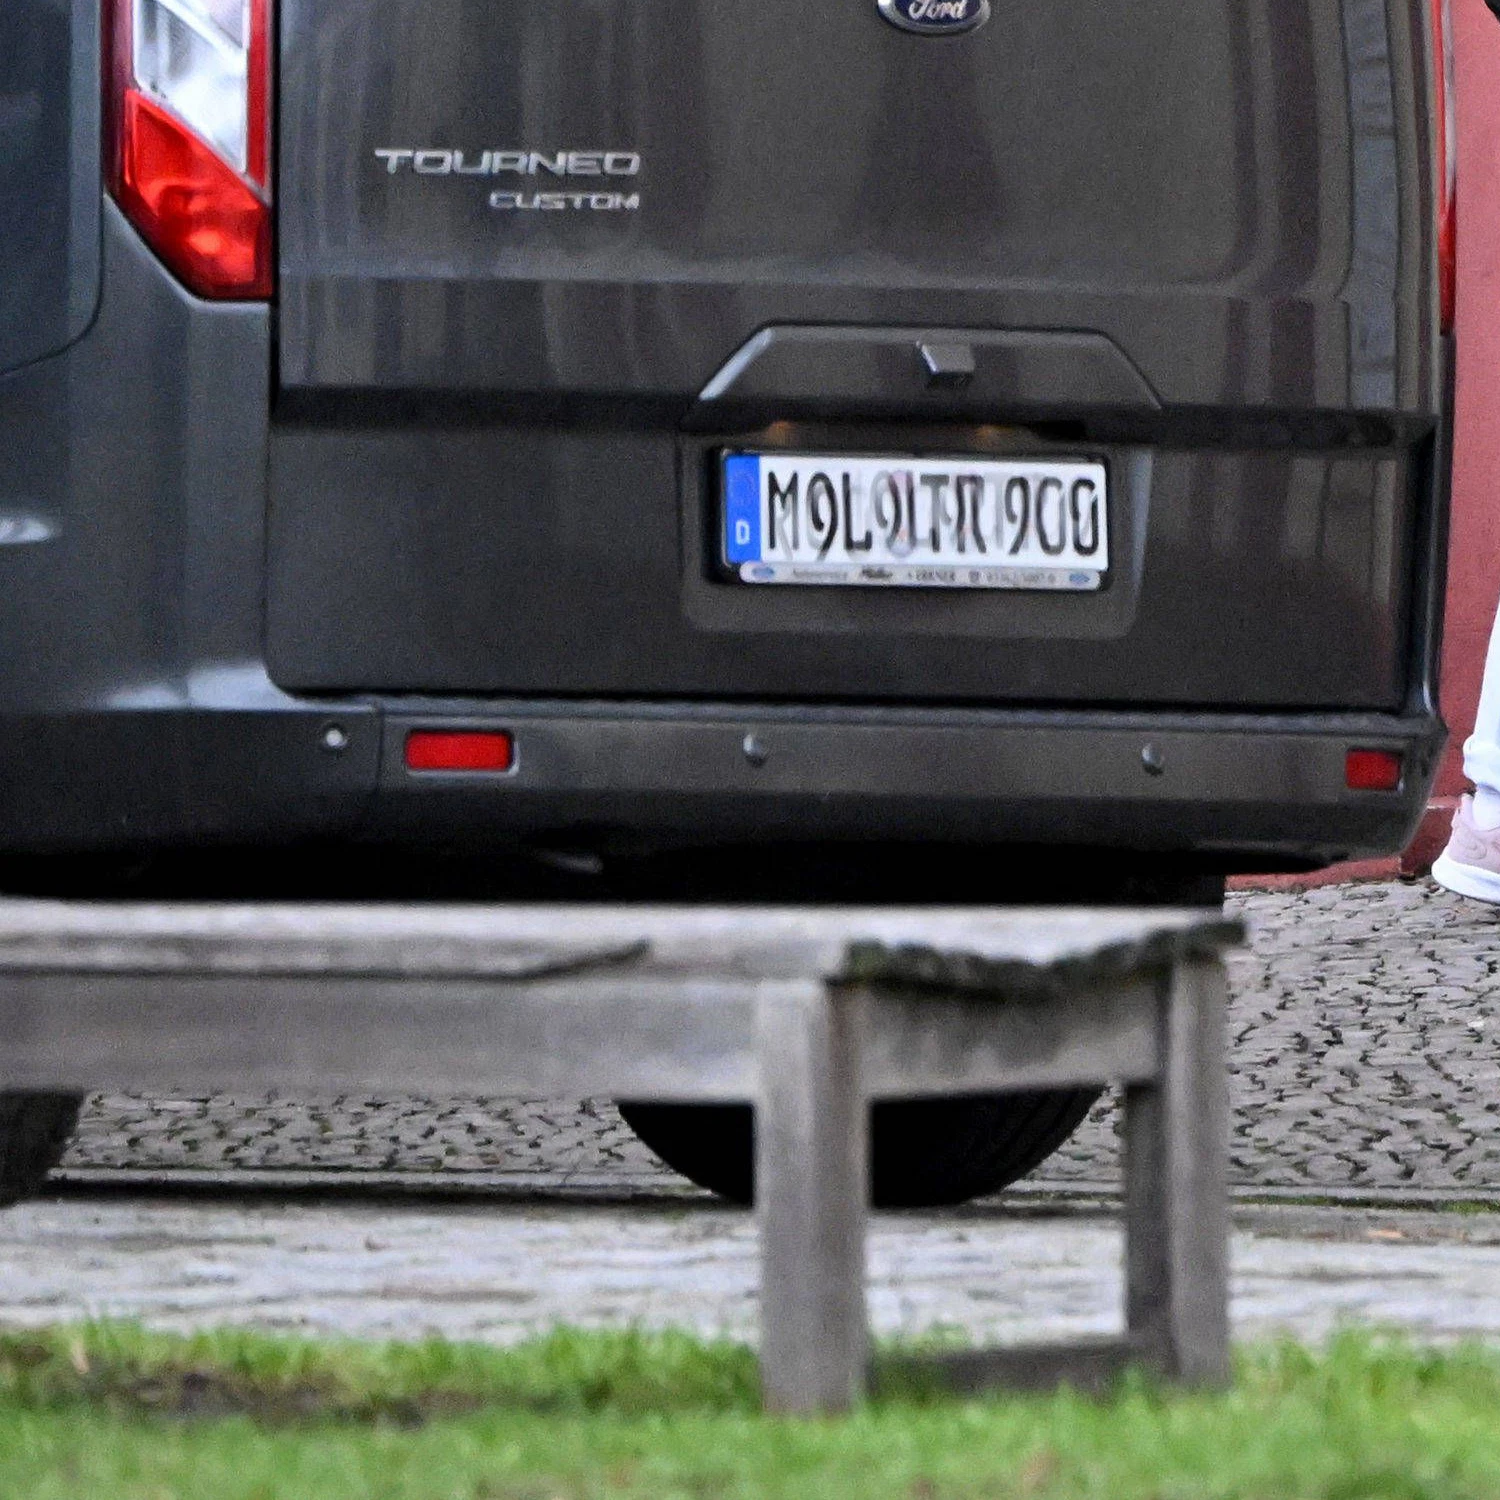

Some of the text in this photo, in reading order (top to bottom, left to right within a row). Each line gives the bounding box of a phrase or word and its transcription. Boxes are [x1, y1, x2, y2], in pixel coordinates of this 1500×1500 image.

[374, 149, 640, 175] TOURNEO
[489, 191, 640, 210] CUSTOM
[735, 520, 750, 544] D
